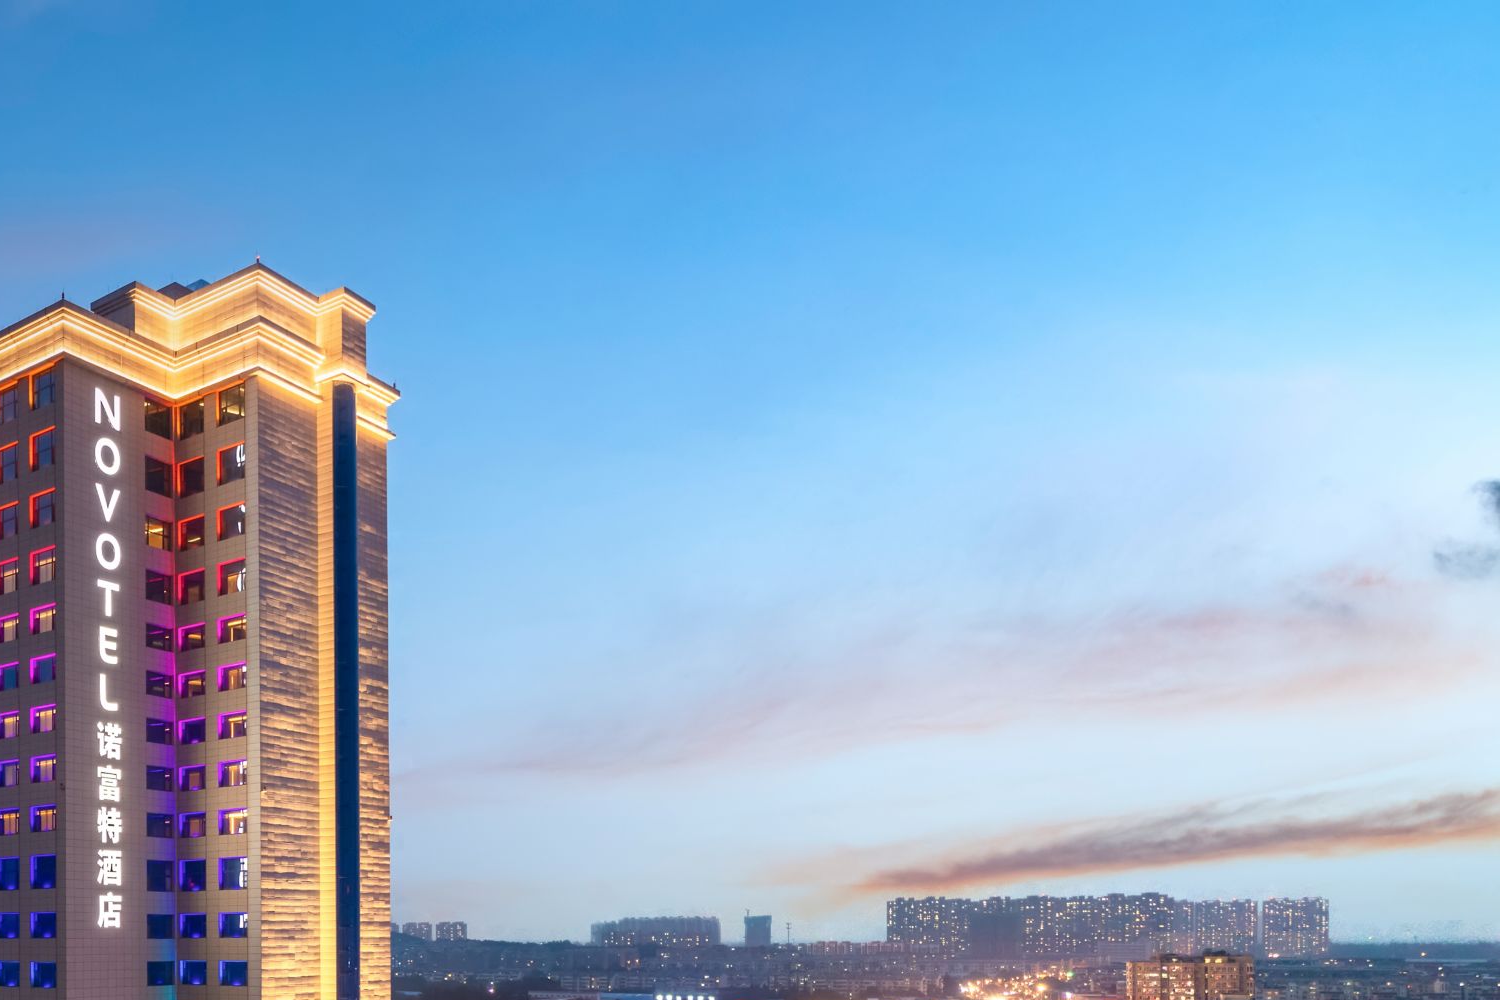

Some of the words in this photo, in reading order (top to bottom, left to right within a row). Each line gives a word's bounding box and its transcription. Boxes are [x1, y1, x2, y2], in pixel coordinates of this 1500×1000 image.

[94, 387, 121, 712] NOVOTEL
[97, 721, 122, 928] 诺富特酒店
